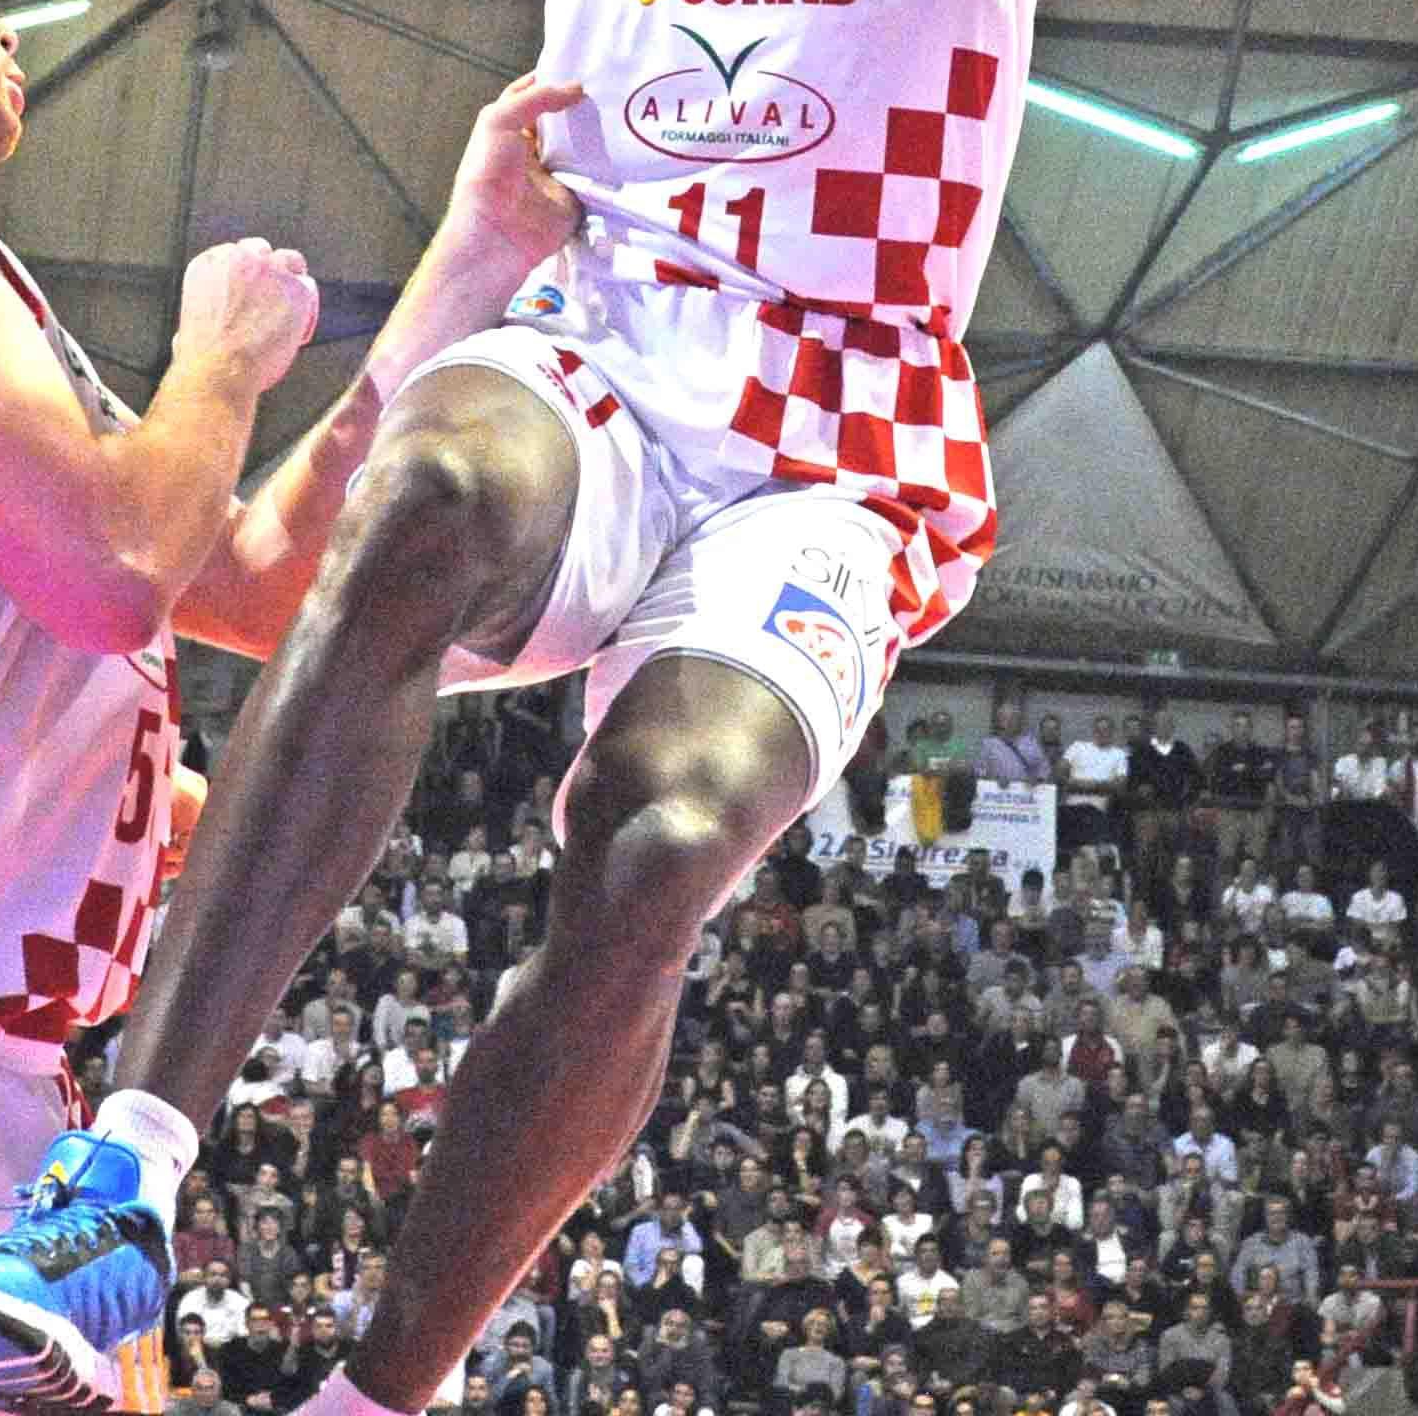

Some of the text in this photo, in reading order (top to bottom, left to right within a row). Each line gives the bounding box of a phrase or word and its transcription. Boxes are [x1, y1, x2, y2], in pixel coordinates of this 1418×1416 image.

[640, 95, 815, 130] ALIVAL
[661, 129, 790, 147] FORMAGGI ITALIANI
[665, 181, 766, 274] 11
